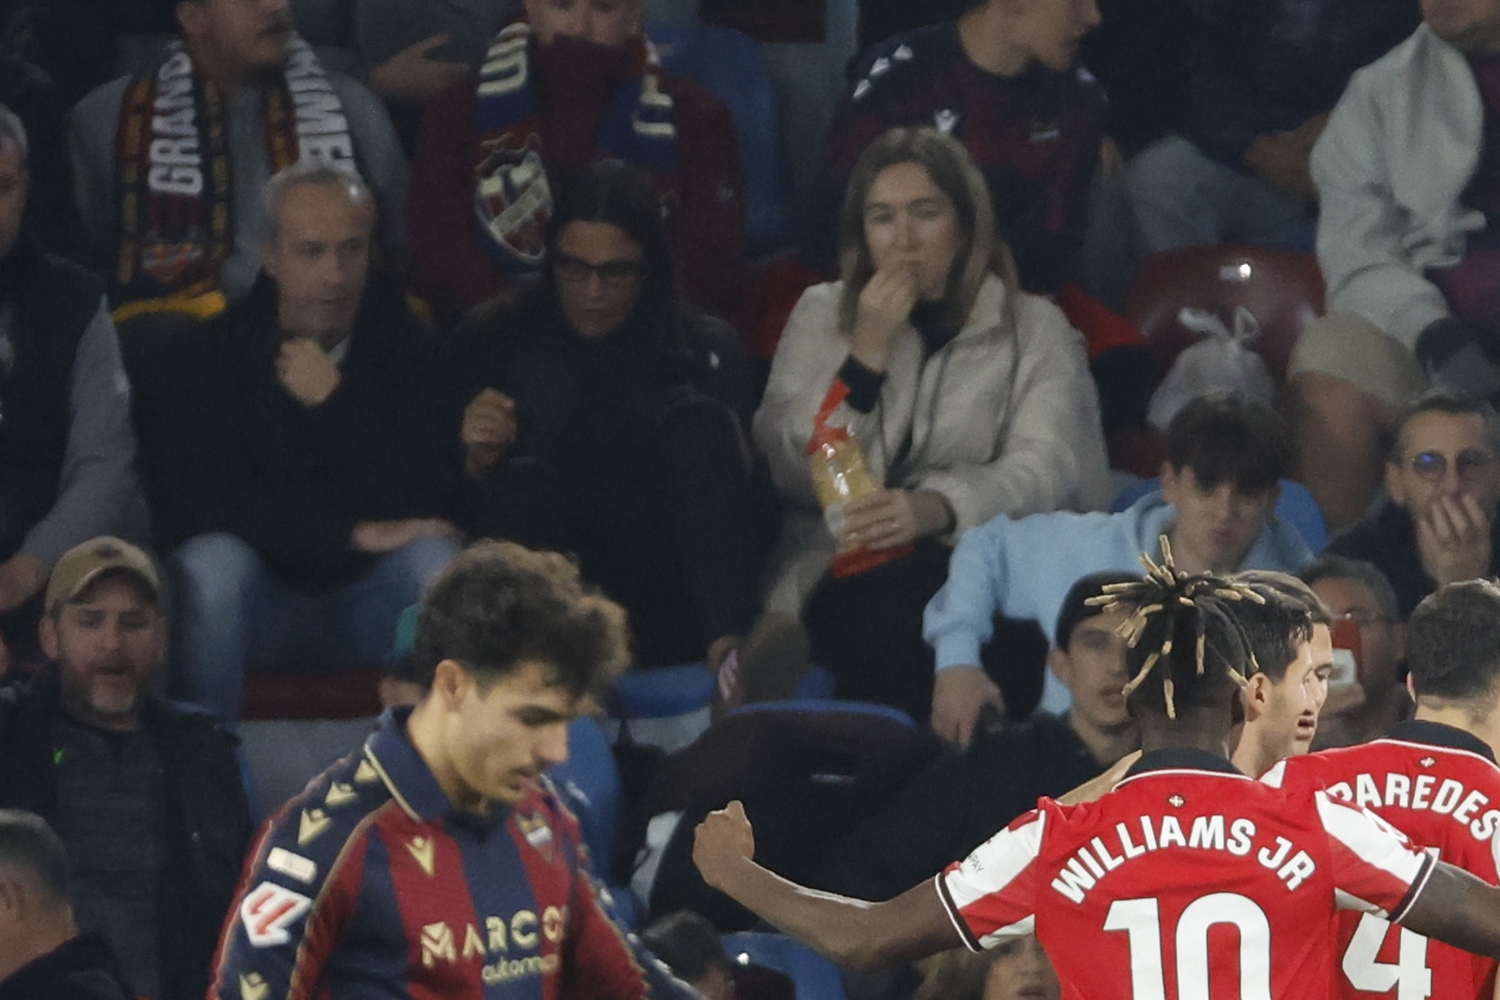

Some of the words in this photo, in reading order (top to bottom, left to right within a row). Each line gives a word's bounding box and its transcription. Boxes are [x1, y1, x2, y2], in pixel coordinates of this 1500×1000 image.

[147, 44, 203, 196] GRANO
[1051, 815, 1258, 904] WILLIAMS
[1256, 835, 1317, 890] JR
[420, 905, 568, 968] MARCO
